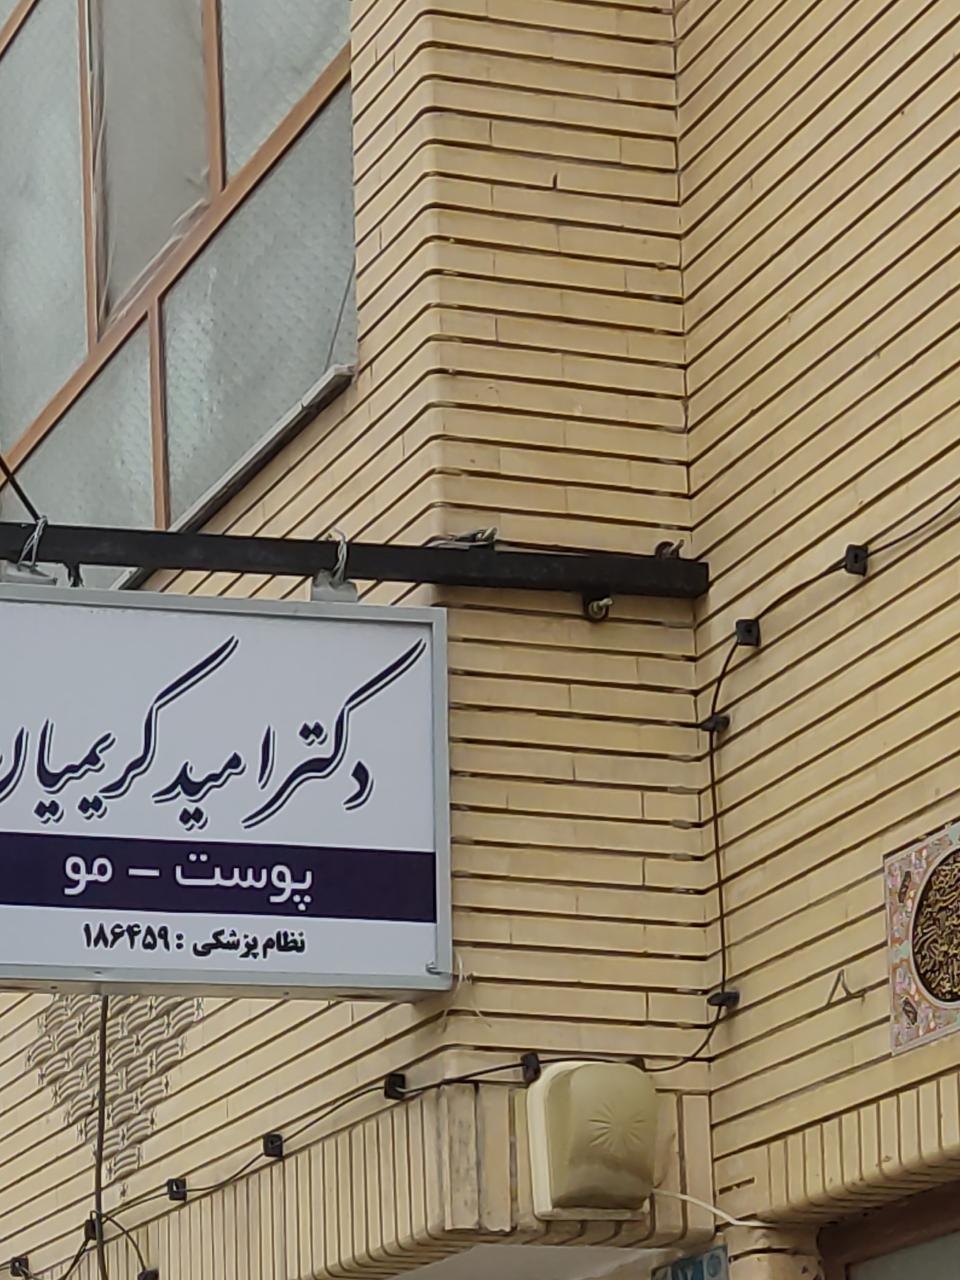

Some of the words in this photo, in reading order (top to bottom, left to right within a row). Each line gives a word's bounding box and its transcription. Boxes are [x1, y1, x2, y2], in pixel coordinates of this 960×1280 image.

[243, 636, 426, 829] دکتر
[152, 725, 275, 831] امید
[63, 852, 114, 896] مو
[174, 851, 313, 911] پوست
[83, 922, 171, 952] ۱۸۶۴۵۹
[262, 931, 306, 959] نظام
